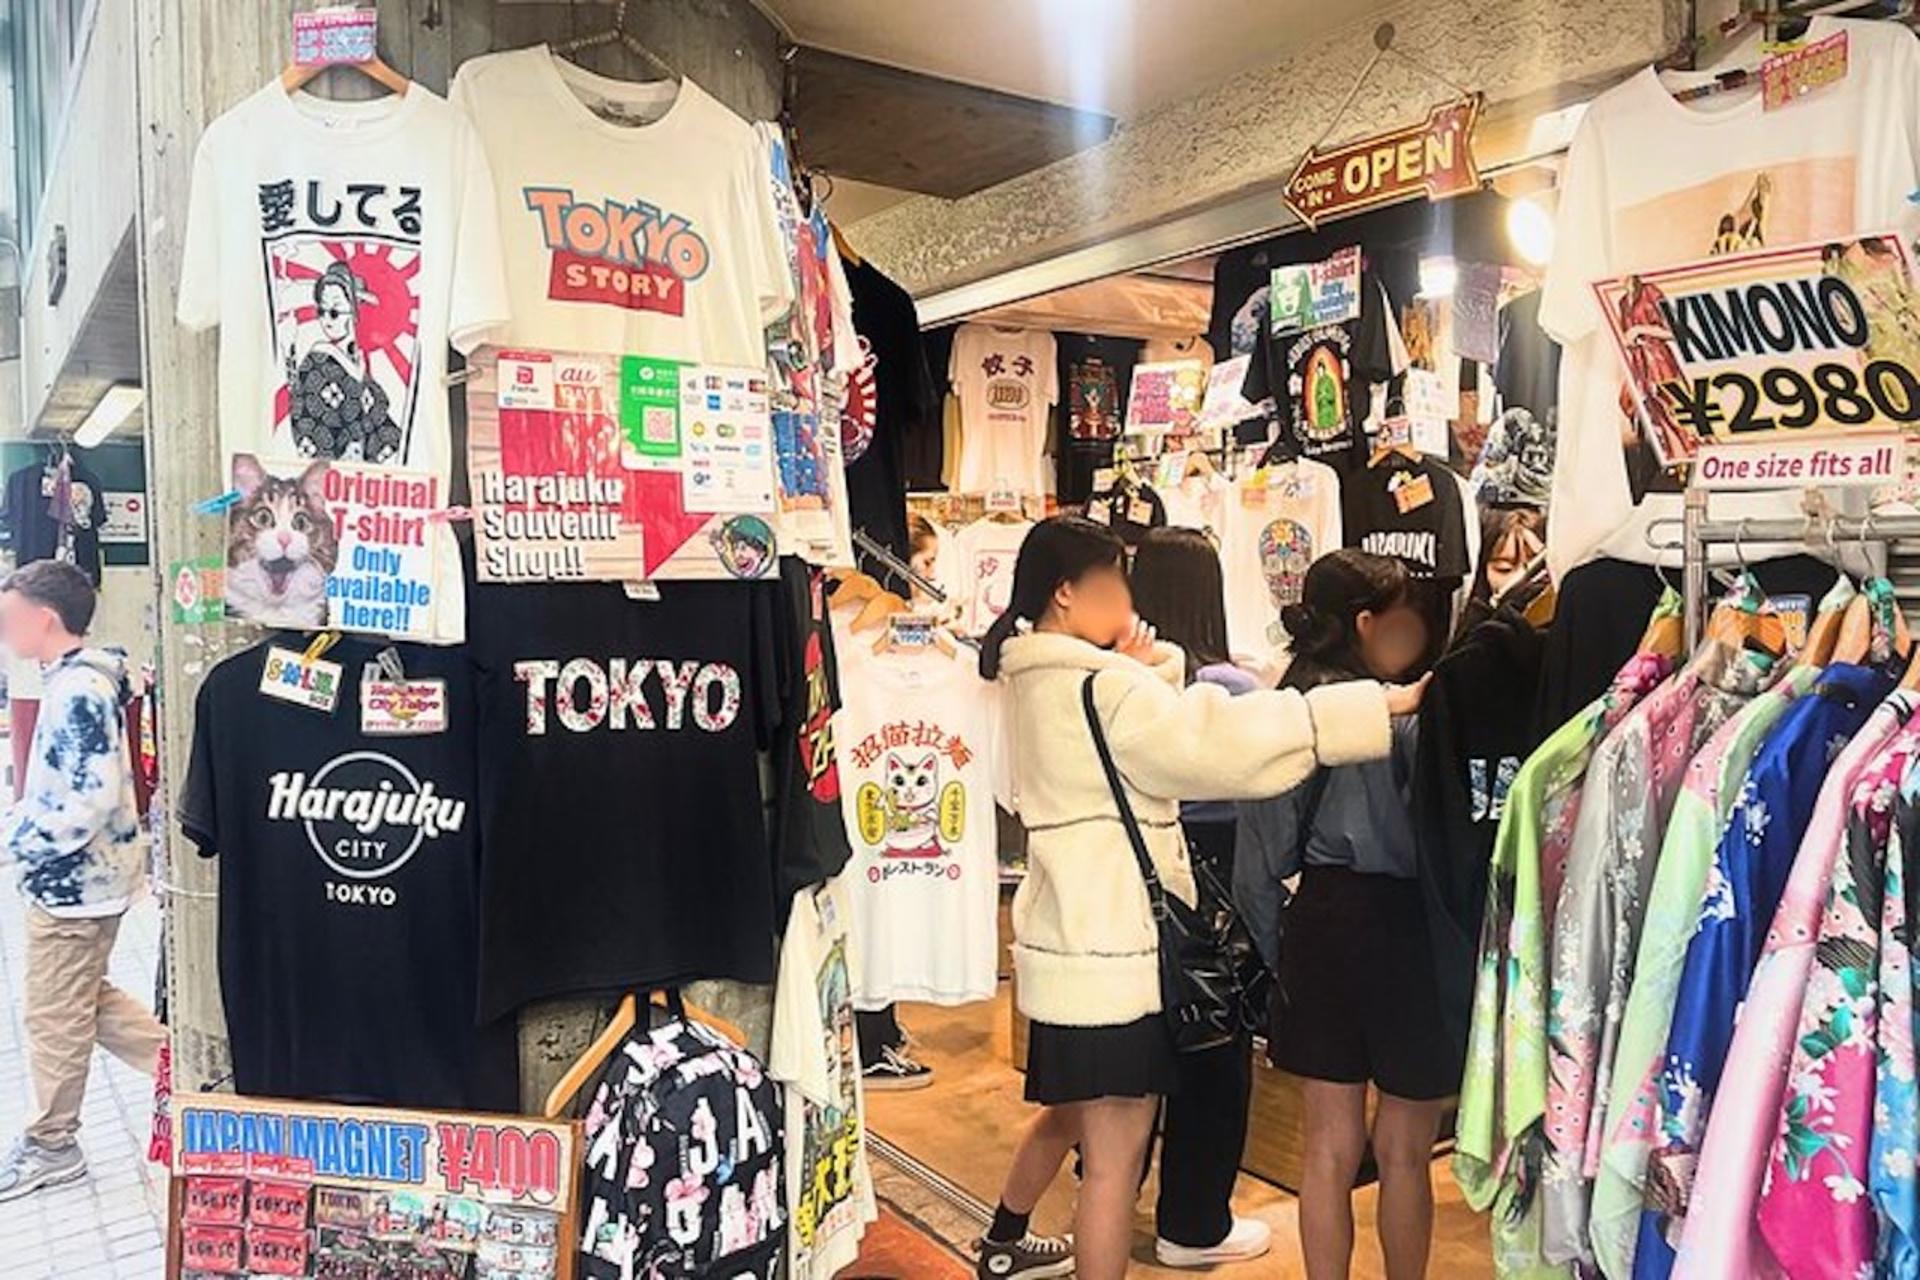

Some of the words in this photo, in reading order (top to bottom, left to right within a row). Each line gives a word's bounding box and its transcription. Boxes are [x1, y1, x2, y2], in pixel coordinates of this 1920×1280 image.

[1293, 166, 1338, 193] COME
[1343, 130, 1455, 194] OPEN
[258, 178, 423, 234] 愛してる
[1307, 191, 1324, 207] IN
[523, 186, 710, 282] TOKYO
[565, 263, 676, 300] STORY
[1659, 277, 1869, 364] KIMONO
[561, 367, 597, 382] au
[1655, 360, 1920, 438] ¥2980
[1703, 456, 1750, 480] One
[1755, 453, 1804, 479] size
[1810, 450, 1853, 477] fits
[1858, 448, 1892, 476] all
[323, 469, 438, 509] Original
[481, 471, 622, 510] Harajuku
[332, 507, 425, 546] T-shirt
[484, 508, 621, 540] Souvenir
[353, 545, 402, 577] Only
[486, 545, 585, 581] Shop!!
[326, 575, 431, 606] available
[343, 602, 410, 631] here!!
[513, 658, 741, 734] TOKYO
[268, 772, 466, 838] Harajuku
[335, 839, 387, 860] CITY
[326, 882, 396, 905] TOKYO
[183, 1109, 284, 1156] JAPAN
[289, 1115, 429, 1184] MAGNET
[437, 1123, 562, 1204] ¥400
